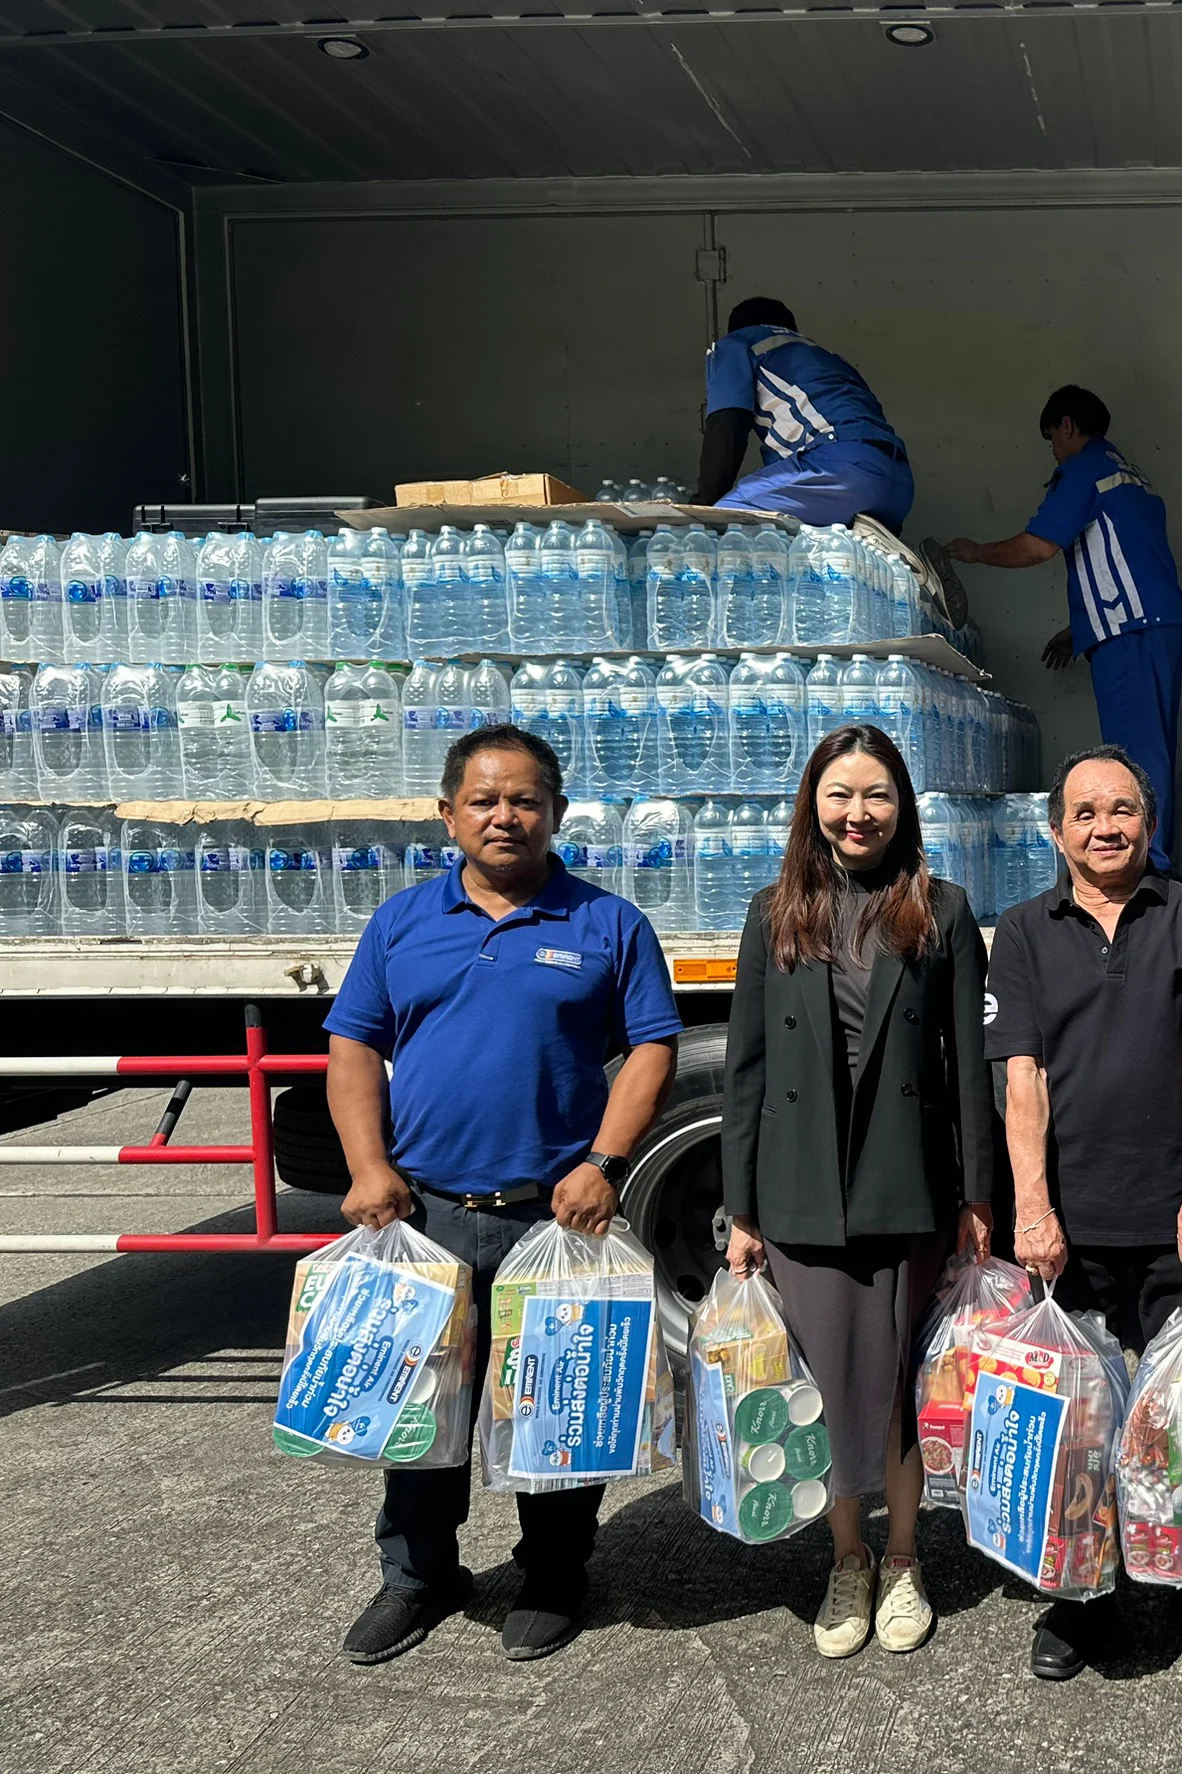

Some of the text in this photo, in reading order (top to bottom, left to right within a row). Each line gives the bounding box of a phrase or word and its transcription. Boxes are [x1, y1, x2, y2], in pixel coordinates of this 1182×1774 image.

[363, 1341, 391, 1389] Eminent Air
[552, 1360, 565, 1410] Eminent Air
[560, 1324, 595, 1447] ร่วมส่งต่อน้ำใจ
[751, 1400, 767, 1434] Knorr
[805, 1432, 818, 1466] Knorr
[990, 1443, 1001, 1492] Eminent Air
[998, 1410, 1020, 1534] ร่วมส่งต่อน้ำใจ
[761, 1493, 777, 1527] Knorr
